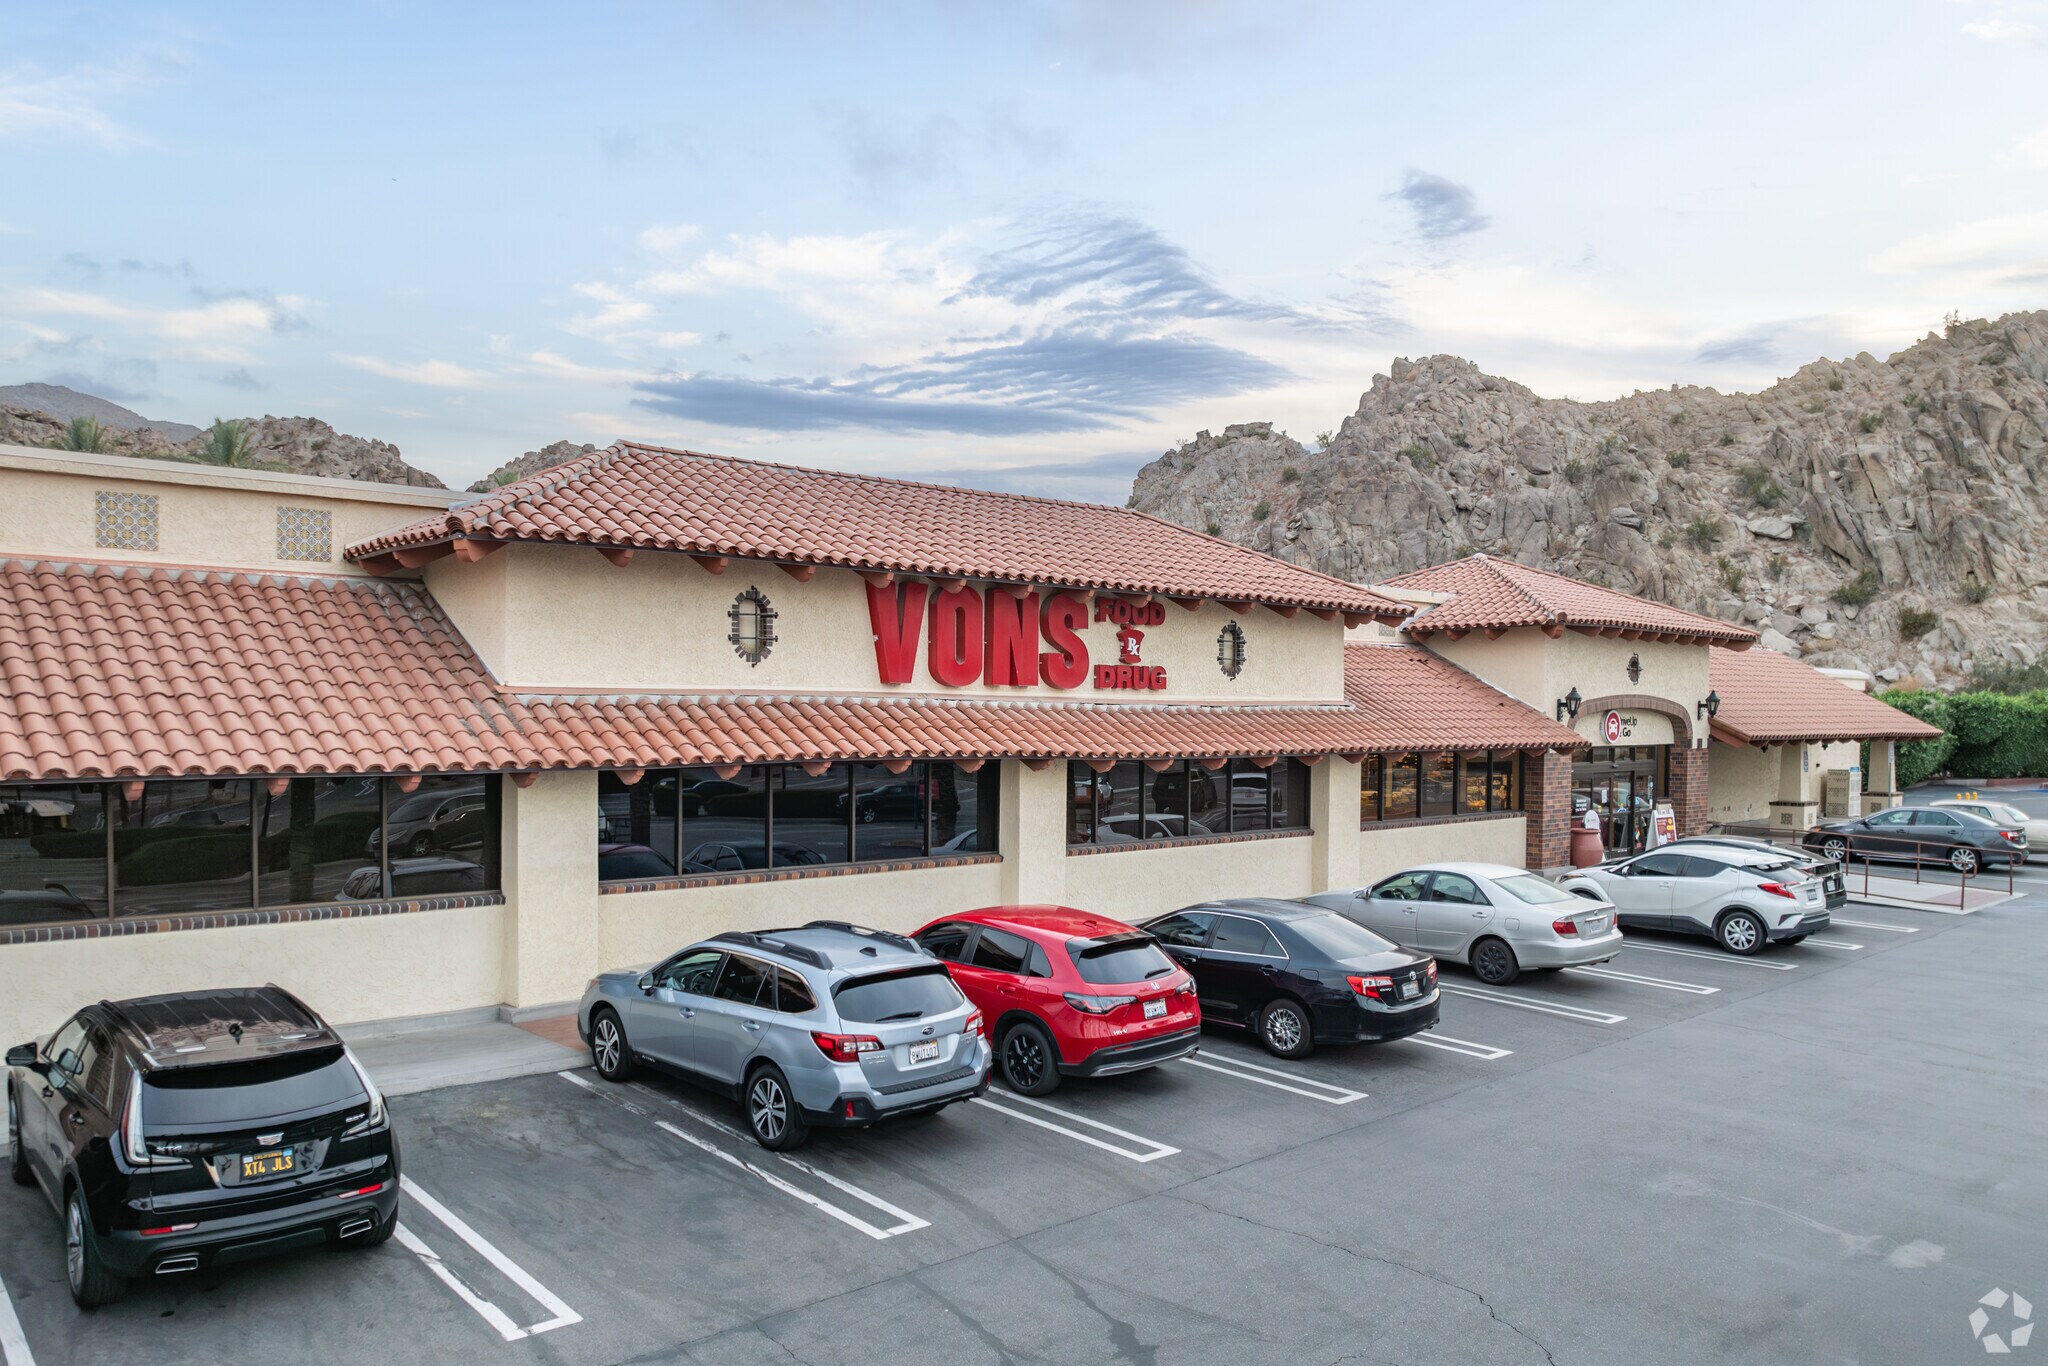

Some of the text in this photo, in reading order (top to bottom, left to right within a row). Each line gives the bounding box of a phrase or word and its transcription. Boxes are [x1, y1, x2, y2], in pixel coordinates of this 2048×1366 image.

[1094, 597, 1166, 626] FOOD
[866, 580, 1090, 690] VONS
[1094, 664, 1167, 690] DRUG
[1622, 727, 1632, 737] Go
[244, 1156, 293, 1177] XT4 JLS
